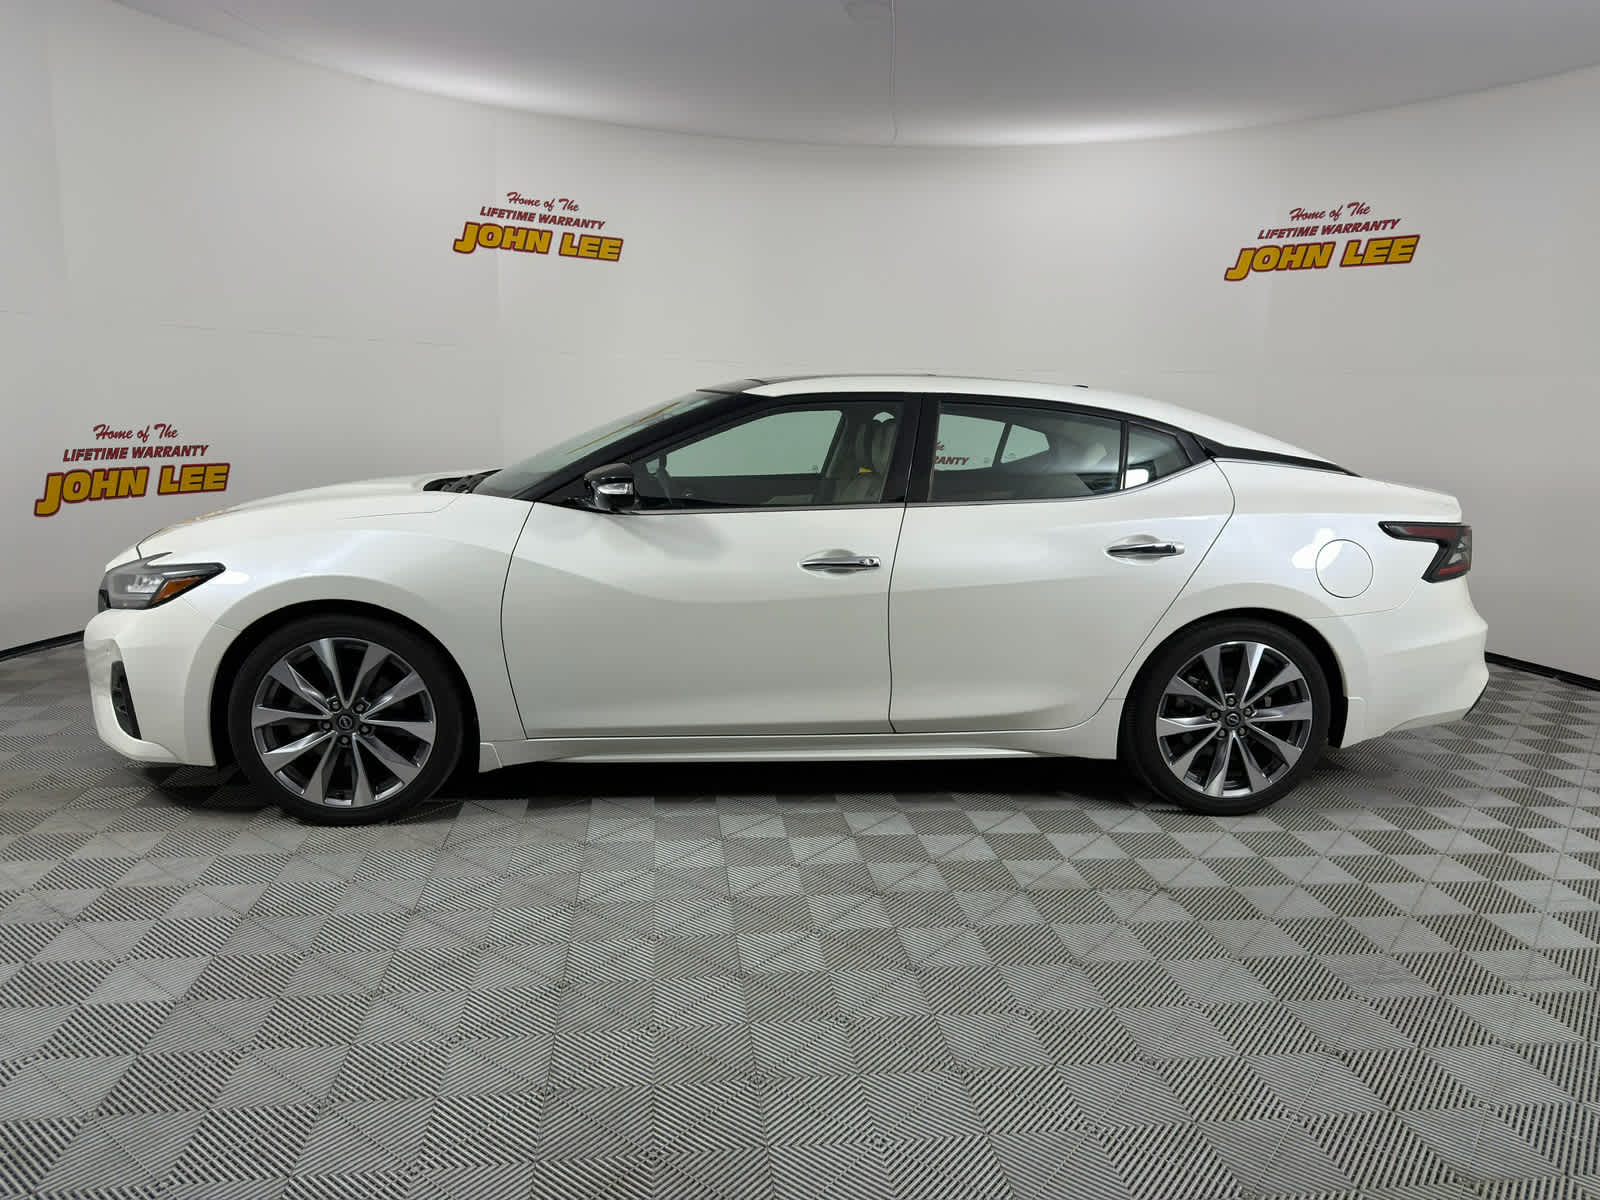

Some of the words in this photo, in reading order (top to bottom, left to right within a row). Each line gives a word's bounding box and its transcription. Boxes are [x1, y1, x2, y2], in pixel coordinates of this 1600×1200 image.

[507, 191, 541, 206] Home
[543, 199, 555, 212] of
[558, 198, 580, 212] The
[1289, 207, 1326, 222] Home
[1329, 205, 1344, 221] of
[1347, 202, 1371, 217] The
[479, 206, 536, 222] LIFETIME
[538, 213, 606, 230] WARRANTY
[1257, 225, 1320, 240] LIFETIME
[1321, 218, 1401, 235] WARRANTY
[452, 221, 554, 255] JOHN
[558, 231, 625, 263] LEE
[1223, 241, 1337, 283] JOHN
[1339, 233, 1421, 269] LEE
[92, 423, 133, 440] Home
[136, 424, 151, 443] of
[153, 423, 179, 439] The
[62, 447, 128, 462] LIFETIME
[131, 444, 209, 459] WARRANTY
[33, 466, 151, 518] JOHN
[156, 462, 231, 497] LEE
